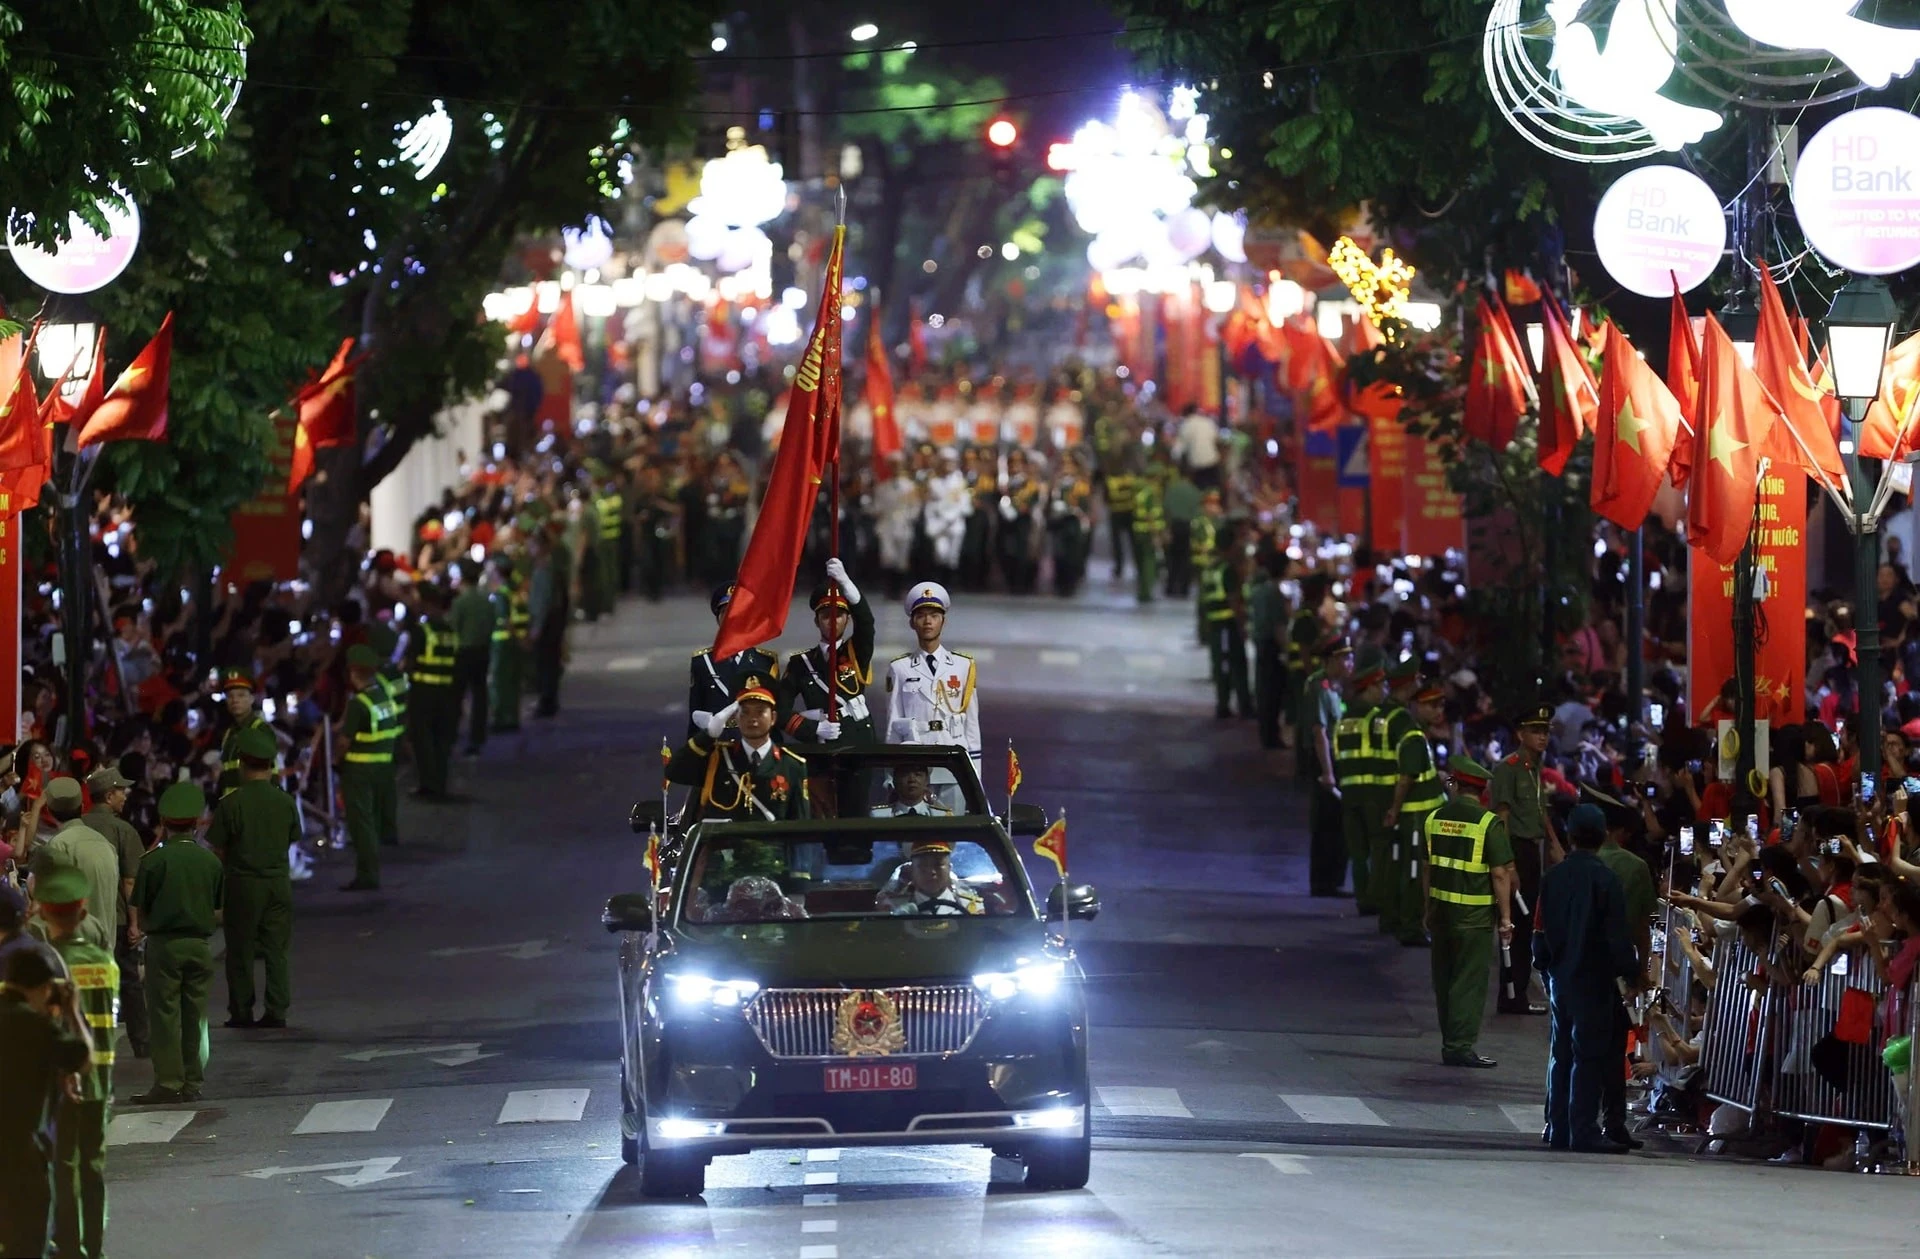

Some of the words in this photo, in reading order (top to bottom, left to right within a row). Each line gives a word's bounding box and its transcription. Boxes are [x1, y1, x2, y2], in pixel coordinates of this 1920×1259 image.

[1831, 136, 1879, 162] HD
[1831, 165, 1913, 192] Bank
[1629, 185, 1667, 208] HD
[1627, 208, 1691, 236] Bank
[1771, 525, 1799, 546] NƯỚC
[828, 1066, 913, 1089] TM-01-80
